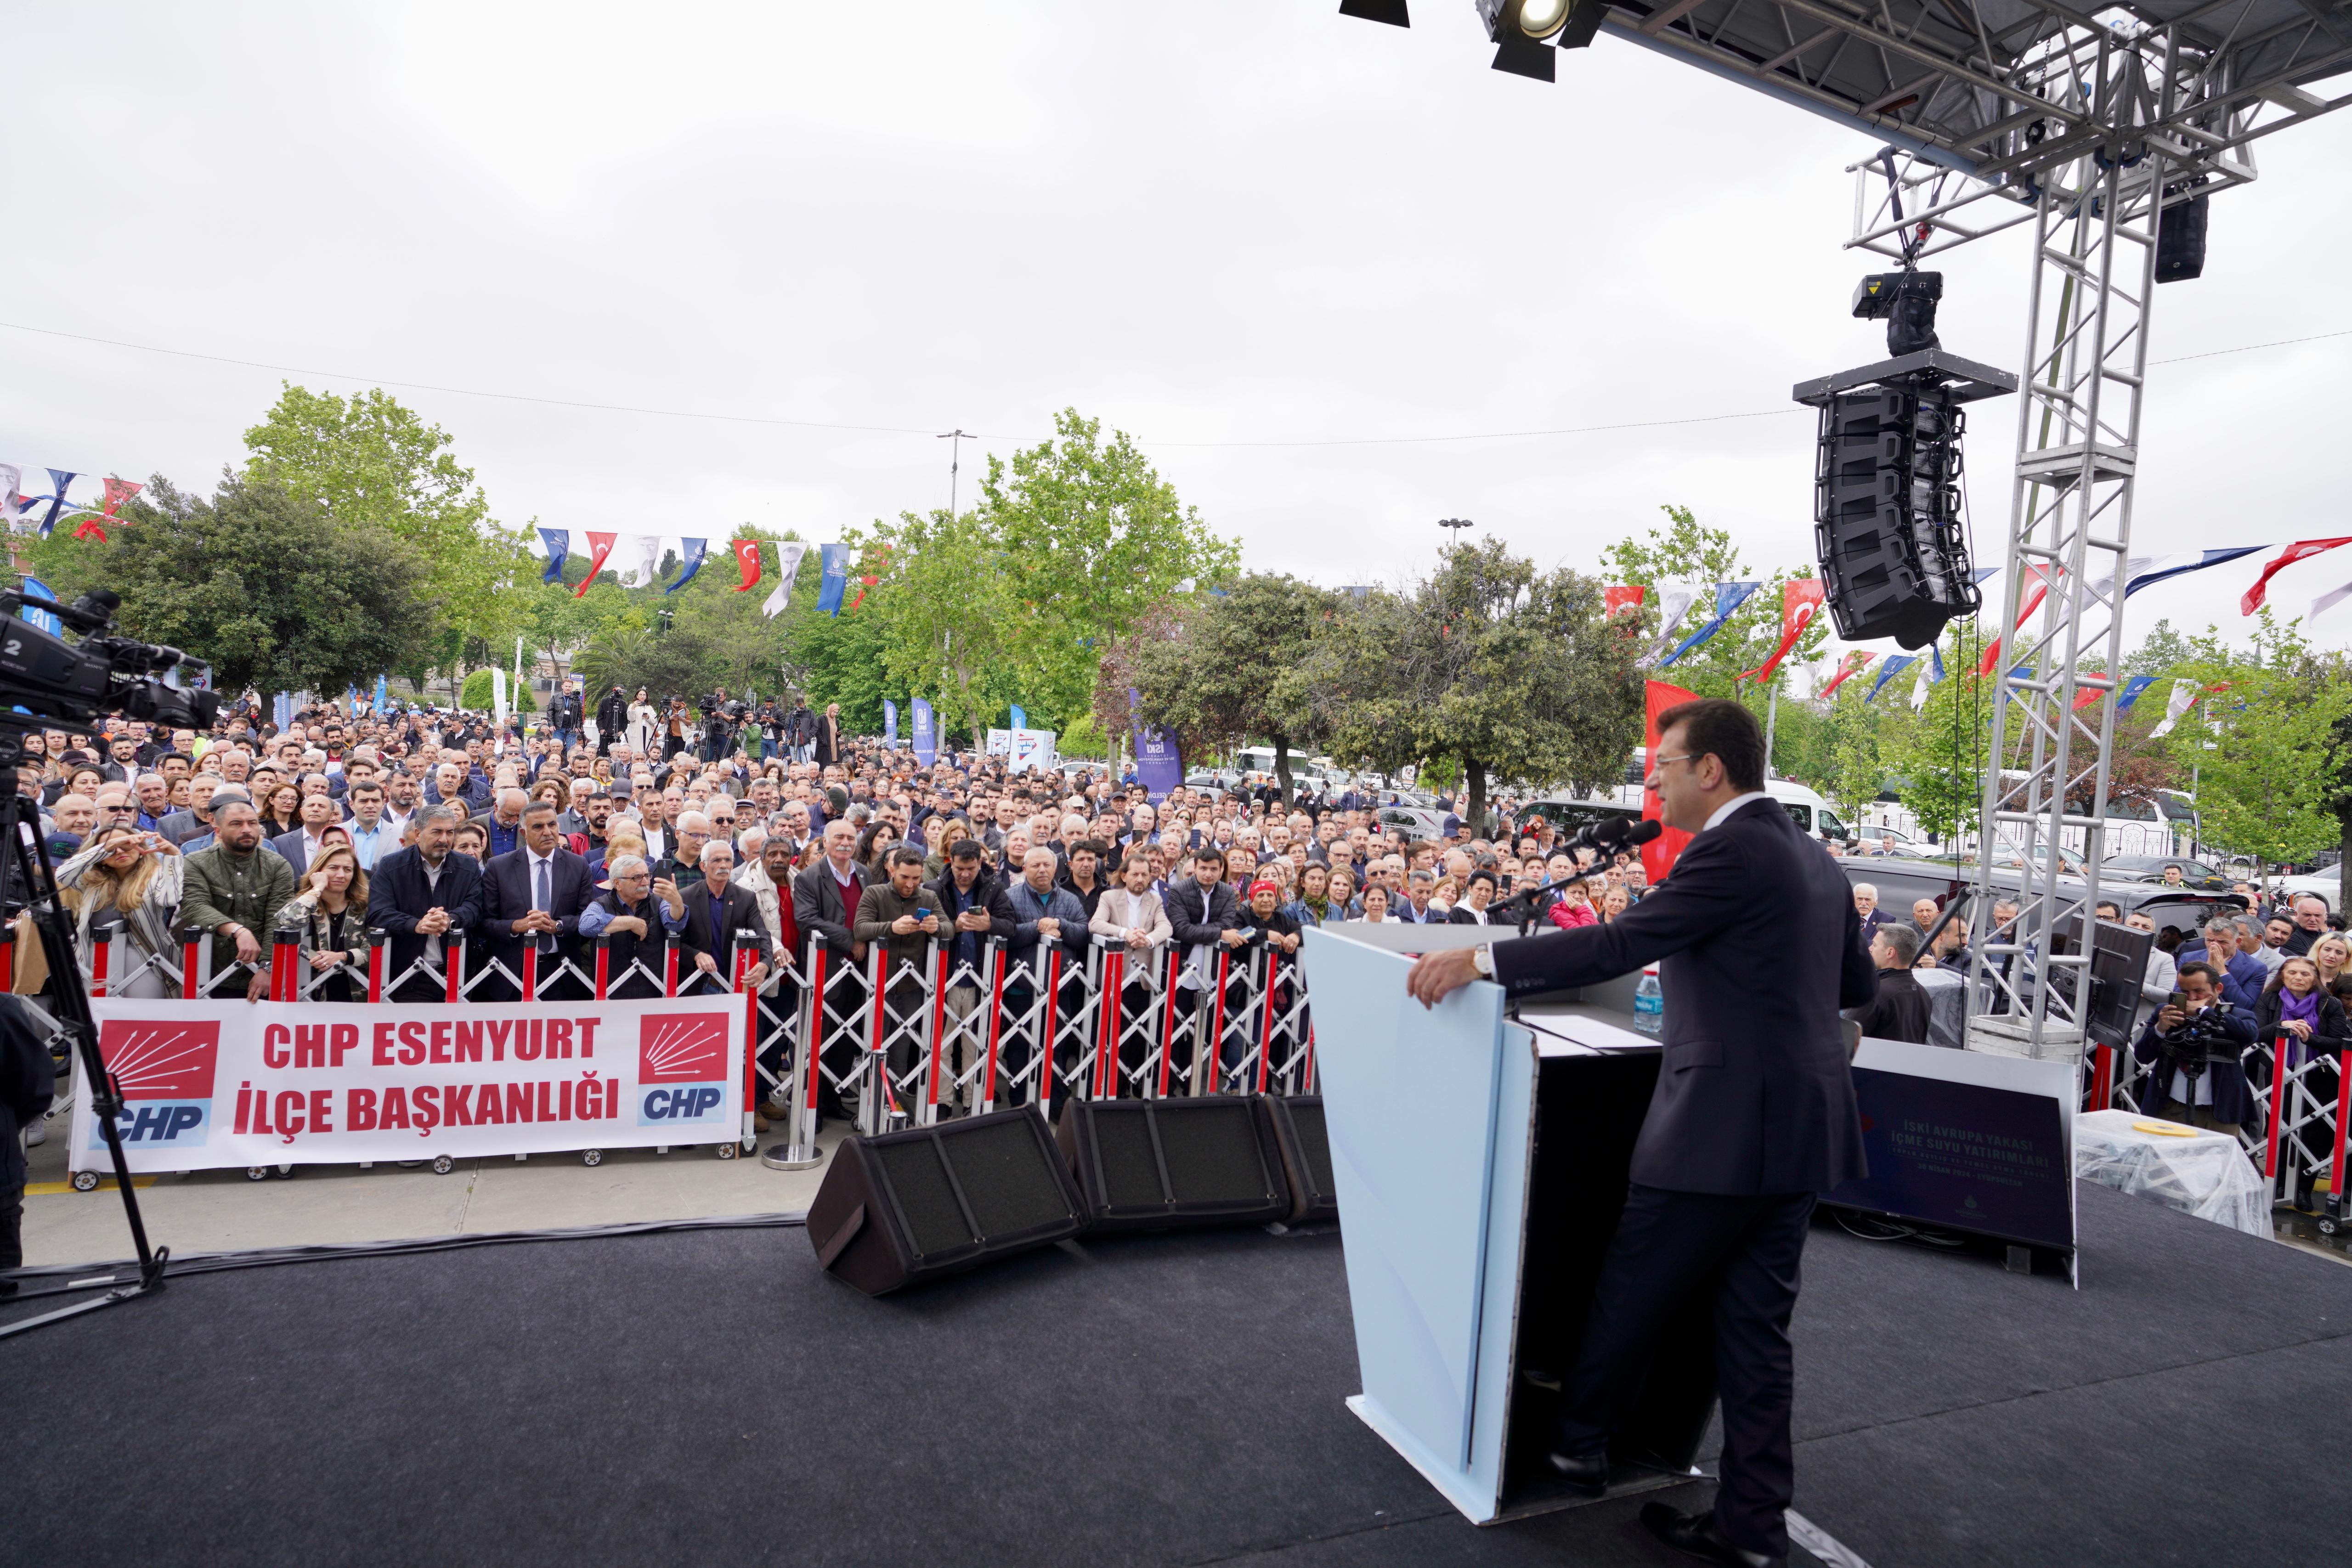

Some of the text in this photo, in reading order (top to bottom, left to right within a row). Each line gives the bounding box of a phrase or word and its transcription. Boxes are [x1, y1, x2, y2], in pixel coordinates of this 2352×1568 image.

[4, 639, 22, 656] 2
[263, 1017, 601, 1069] CHP ESENYURT
[232, 1070, 618, 1144] İLÇE BAŞKANLIĞI
[644, 1088, 720, 1120] CHP
[98, 1106, 203, 1143] CHP
[1904, 1119, 2033, 1151] İSKİ AVRUPA YAKASI
[1891, 1131, 2049, 1168] İÇME SUYU YATIRIMLARI
